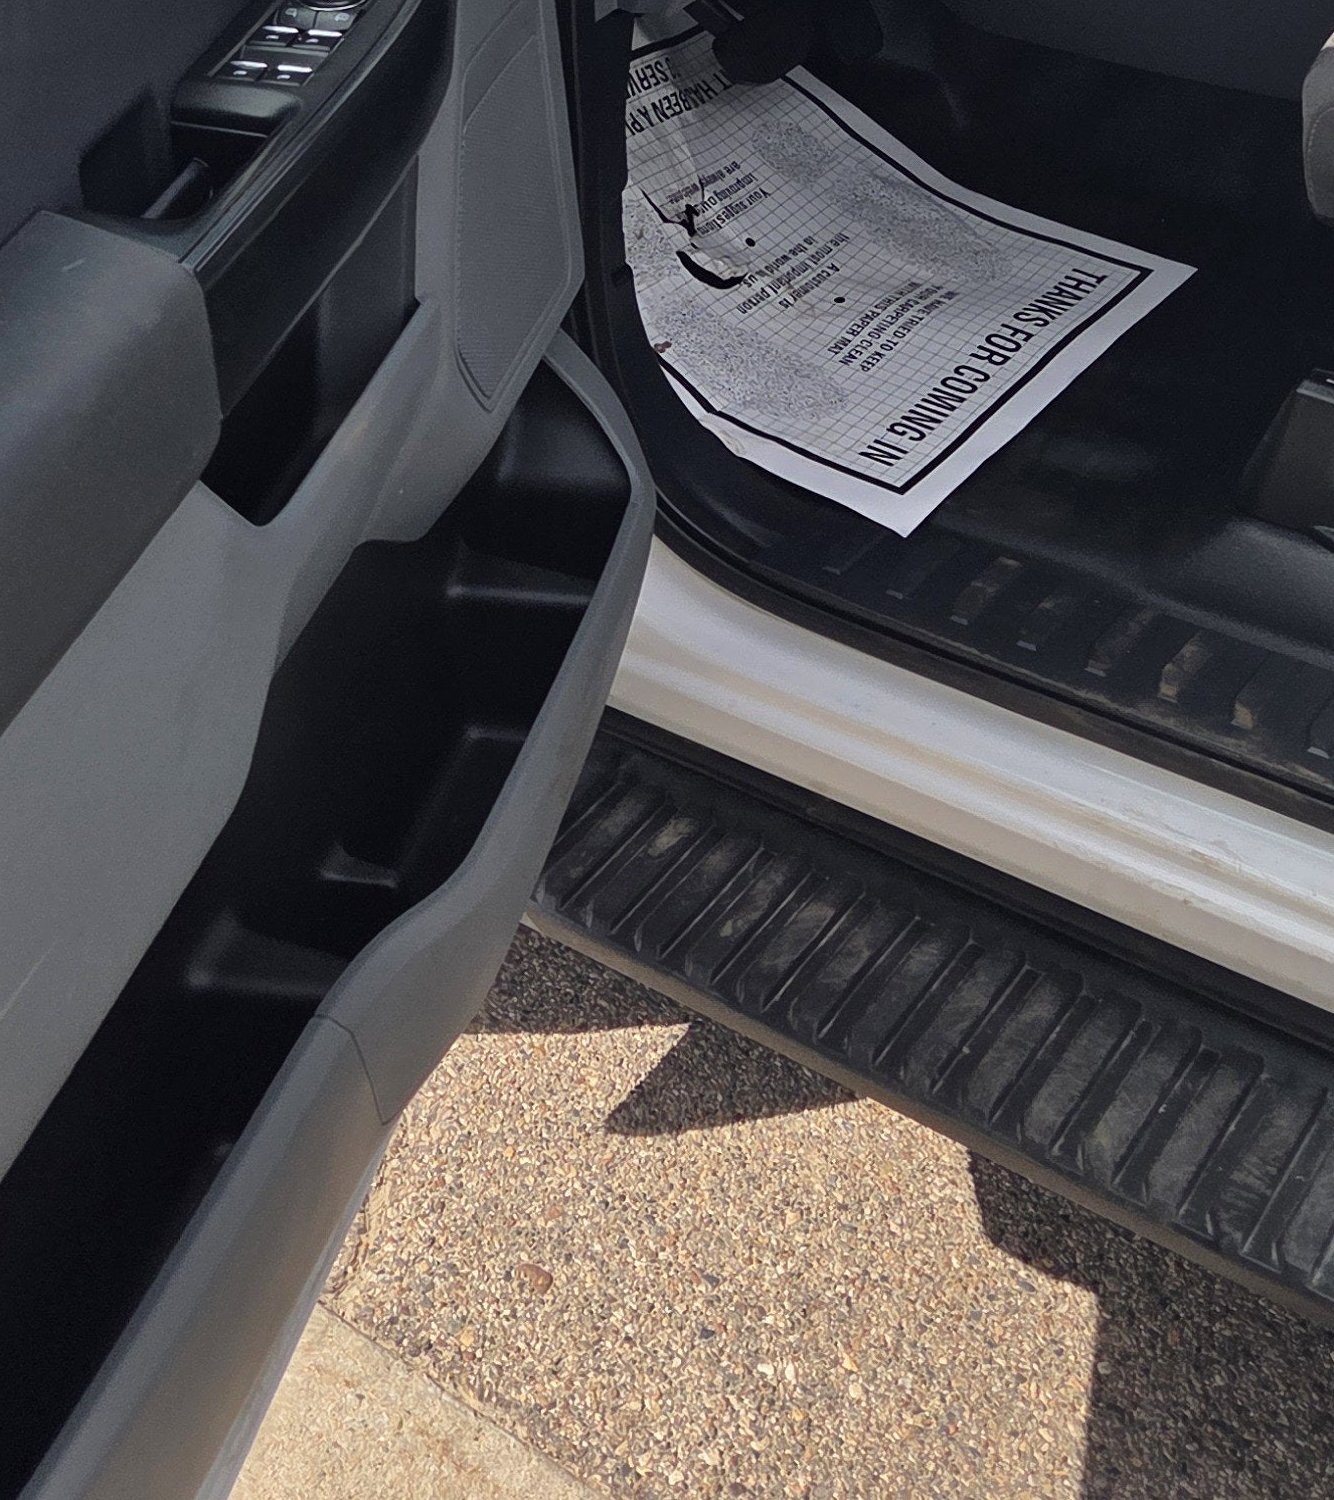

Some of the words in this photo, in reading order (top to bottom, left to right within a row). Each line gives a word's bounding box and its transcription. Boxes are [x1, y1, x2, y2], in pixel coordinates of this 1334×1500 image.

[722, 160, 741, 175] are
[712, 172, 758, 202] improving
[745, 187, 770, 206] Your
[830, 232, 850, 246] the
[763, 253, 791, 274] world
[805, 244, 833, 266] most
[826, 262, 840, 272] A
[765, 260, 812, 294] important
[789, 269, 831, 302] customer
[735, 287, 771, 314] person
[1012, 268, 1108, 328] THANKS
[844, 308, 880, 336] PAPER
[866, 297, 920, 340] CARPETING
[891, 313, 924, 339] TRIED
[826, 335, 852, 355] MAT
[837, 338, 873, 366] CLEAN
[878, 336, 898, 352] TO
[969, 323, 1034, 366] FOR
[860, 349, 886, 372] KEEP
[886, 364, 991, 442] COMING
[858, 438, 909, 467] IN
